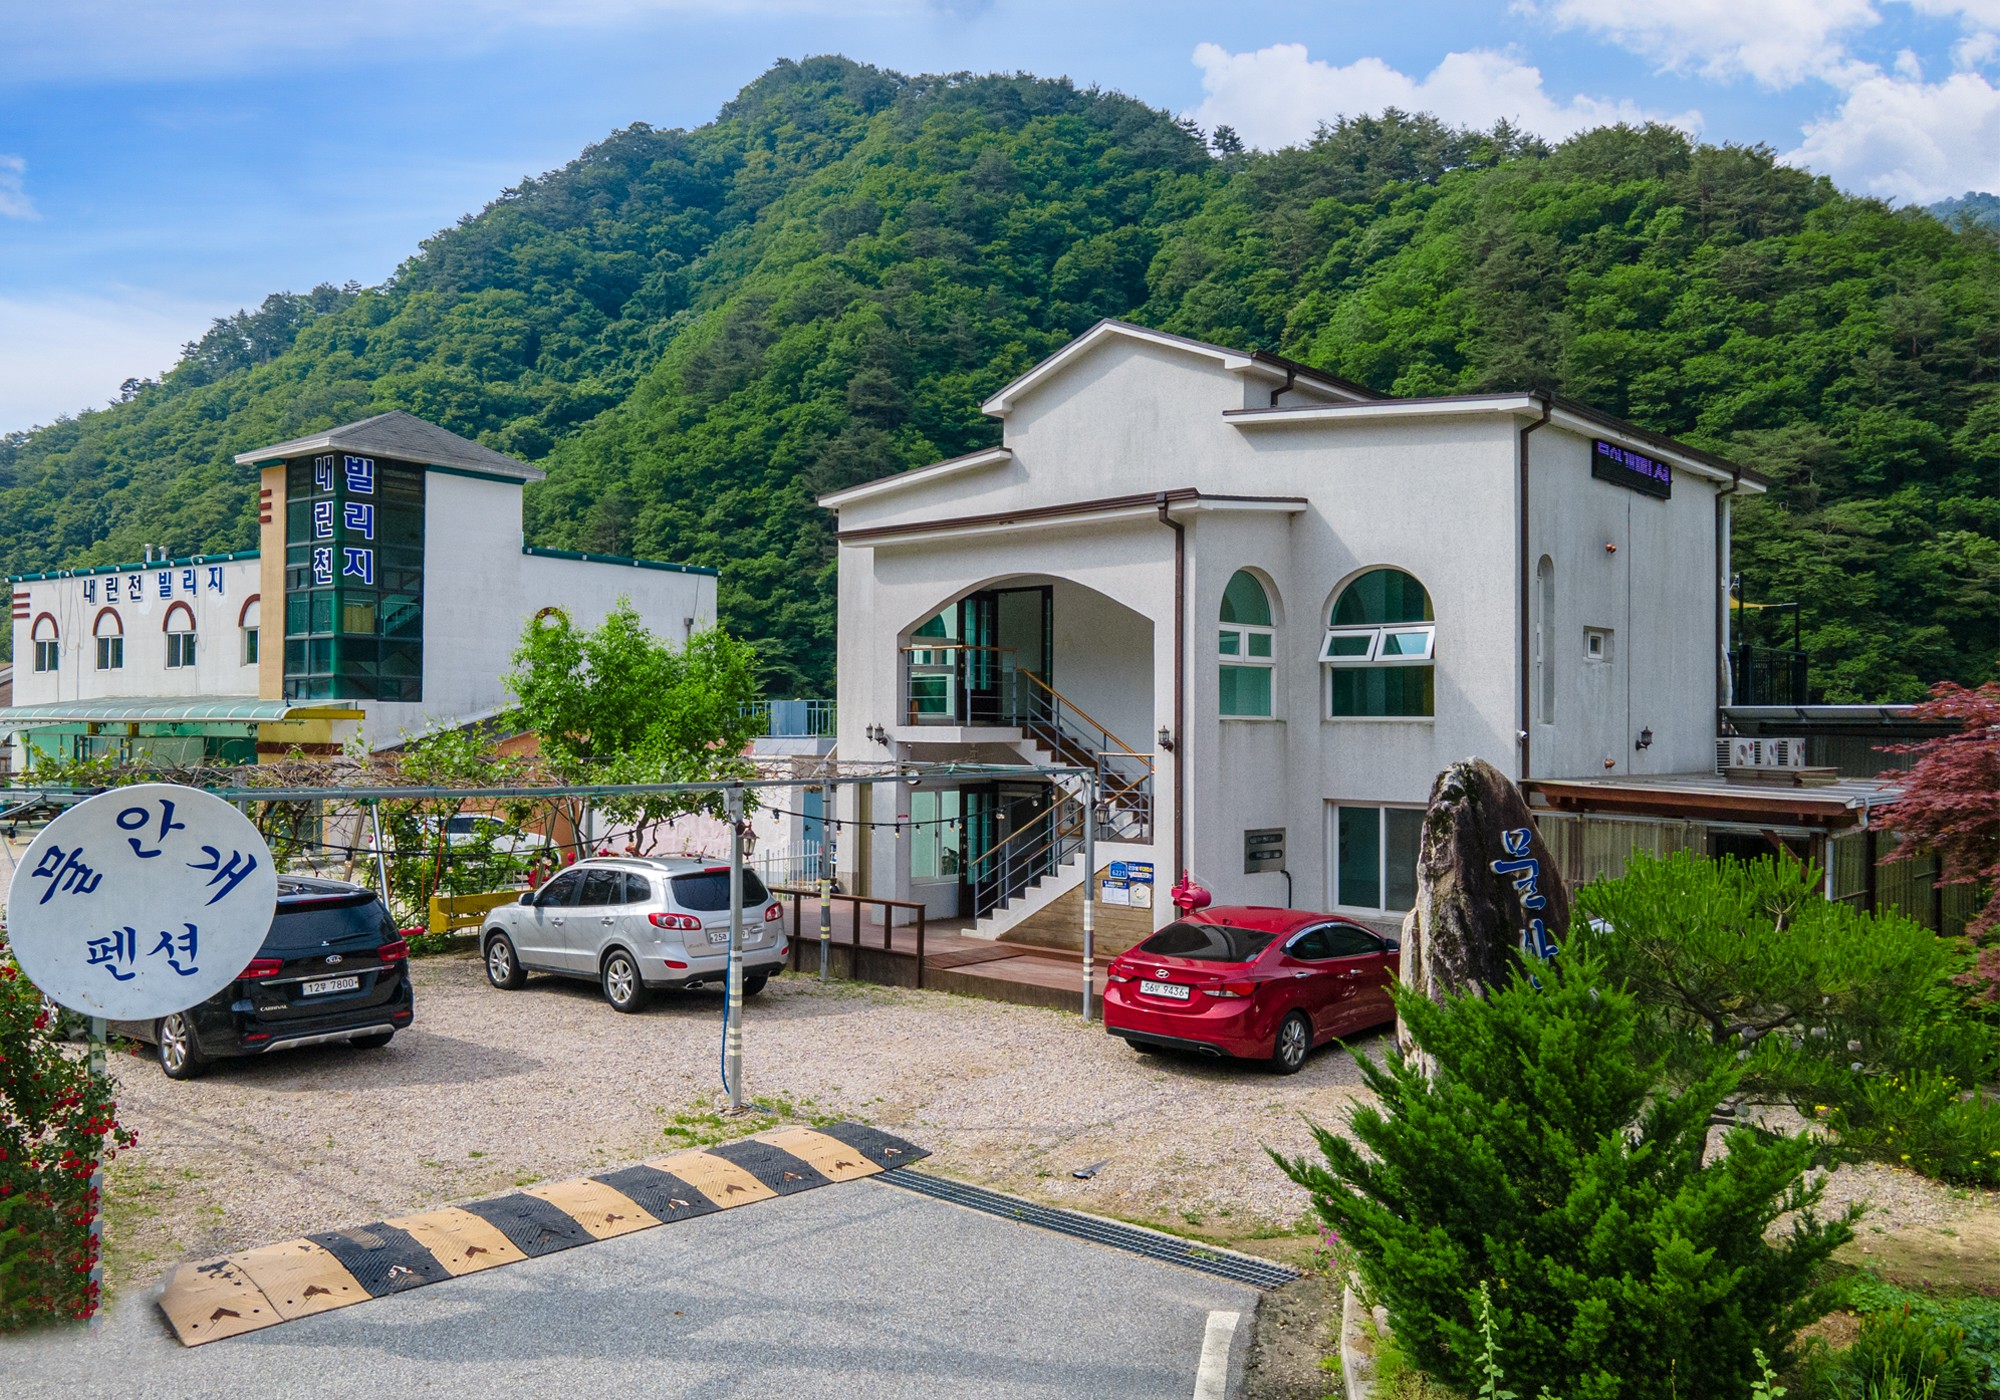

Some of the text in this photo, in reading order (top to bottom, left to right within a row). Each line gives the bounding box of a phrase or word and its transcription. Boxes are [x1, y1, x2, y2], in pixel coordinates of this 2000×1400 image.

[314, 454, 334, 584] 내린천
[343, 455, 374, 585] 빌리지
[83, 566, 225, 605] 내린천 빌리지
[1111, 869, 1125, 877] 6221
[86, 923, 199, 981] 펜션
[330, 978, 354, 990] 7800
[1163, 985, 1185, 997] 9436
